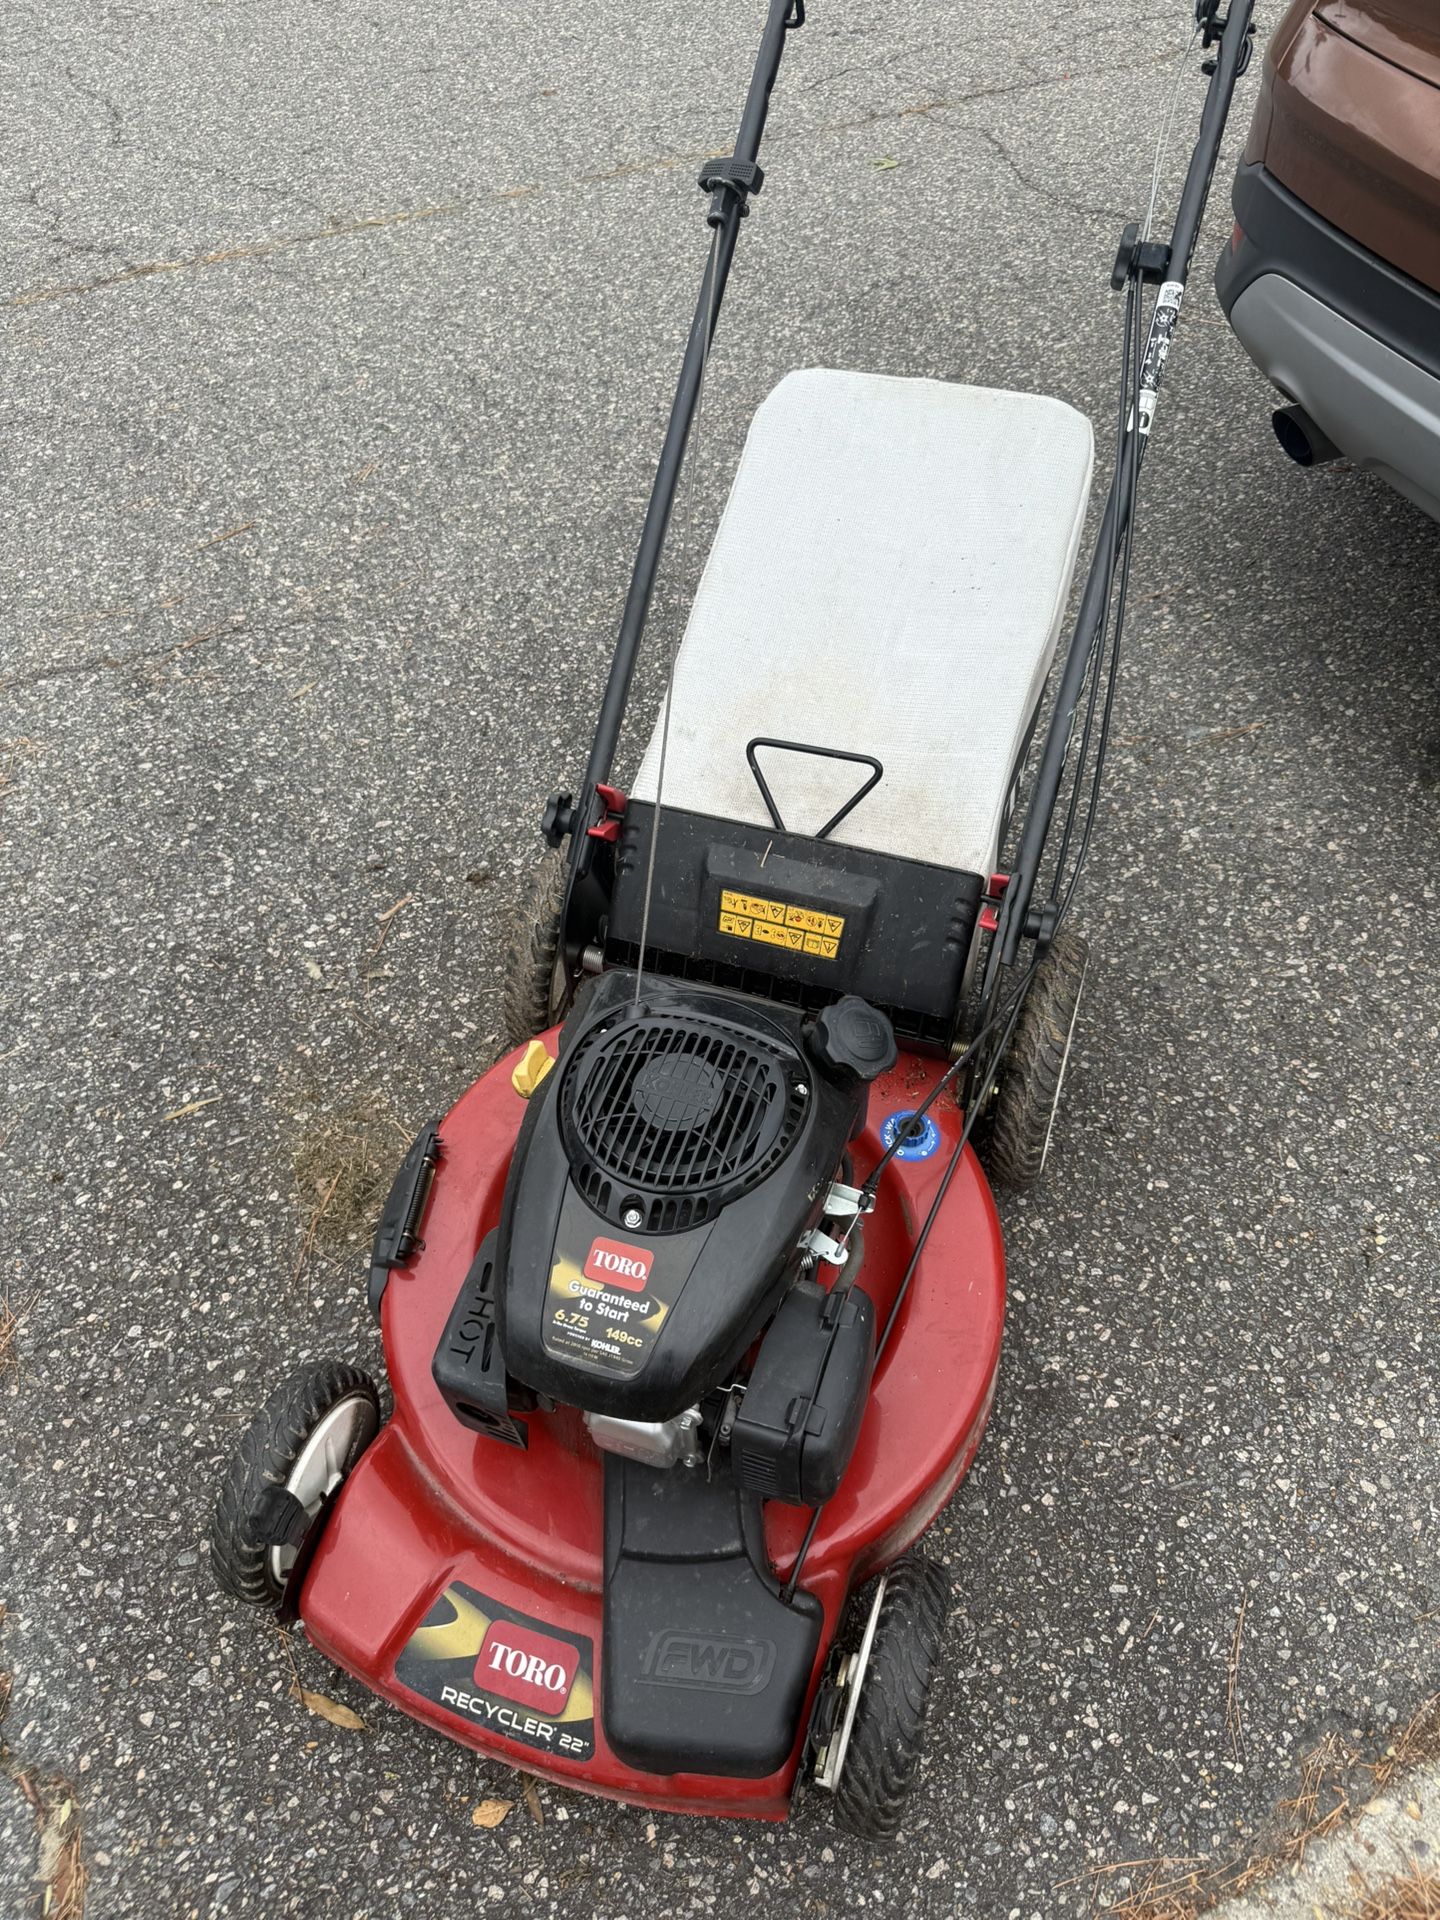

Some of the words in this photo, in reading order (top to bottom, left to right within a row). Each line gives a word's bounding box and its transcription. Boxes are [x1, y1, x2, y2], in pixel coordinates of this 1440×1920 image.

[568, 1279, 650, 1314] Guaranteed
[579, 1298, 593, 1312] to
[595, 1302, 629, 1323] Start
[450, 1296, 494, 1364] HOT
[554, 1308, 589, 1328] 6.75
[606, 1328, 643, 1348] 149cc
[662, 1642, 754, 1680] FWD
